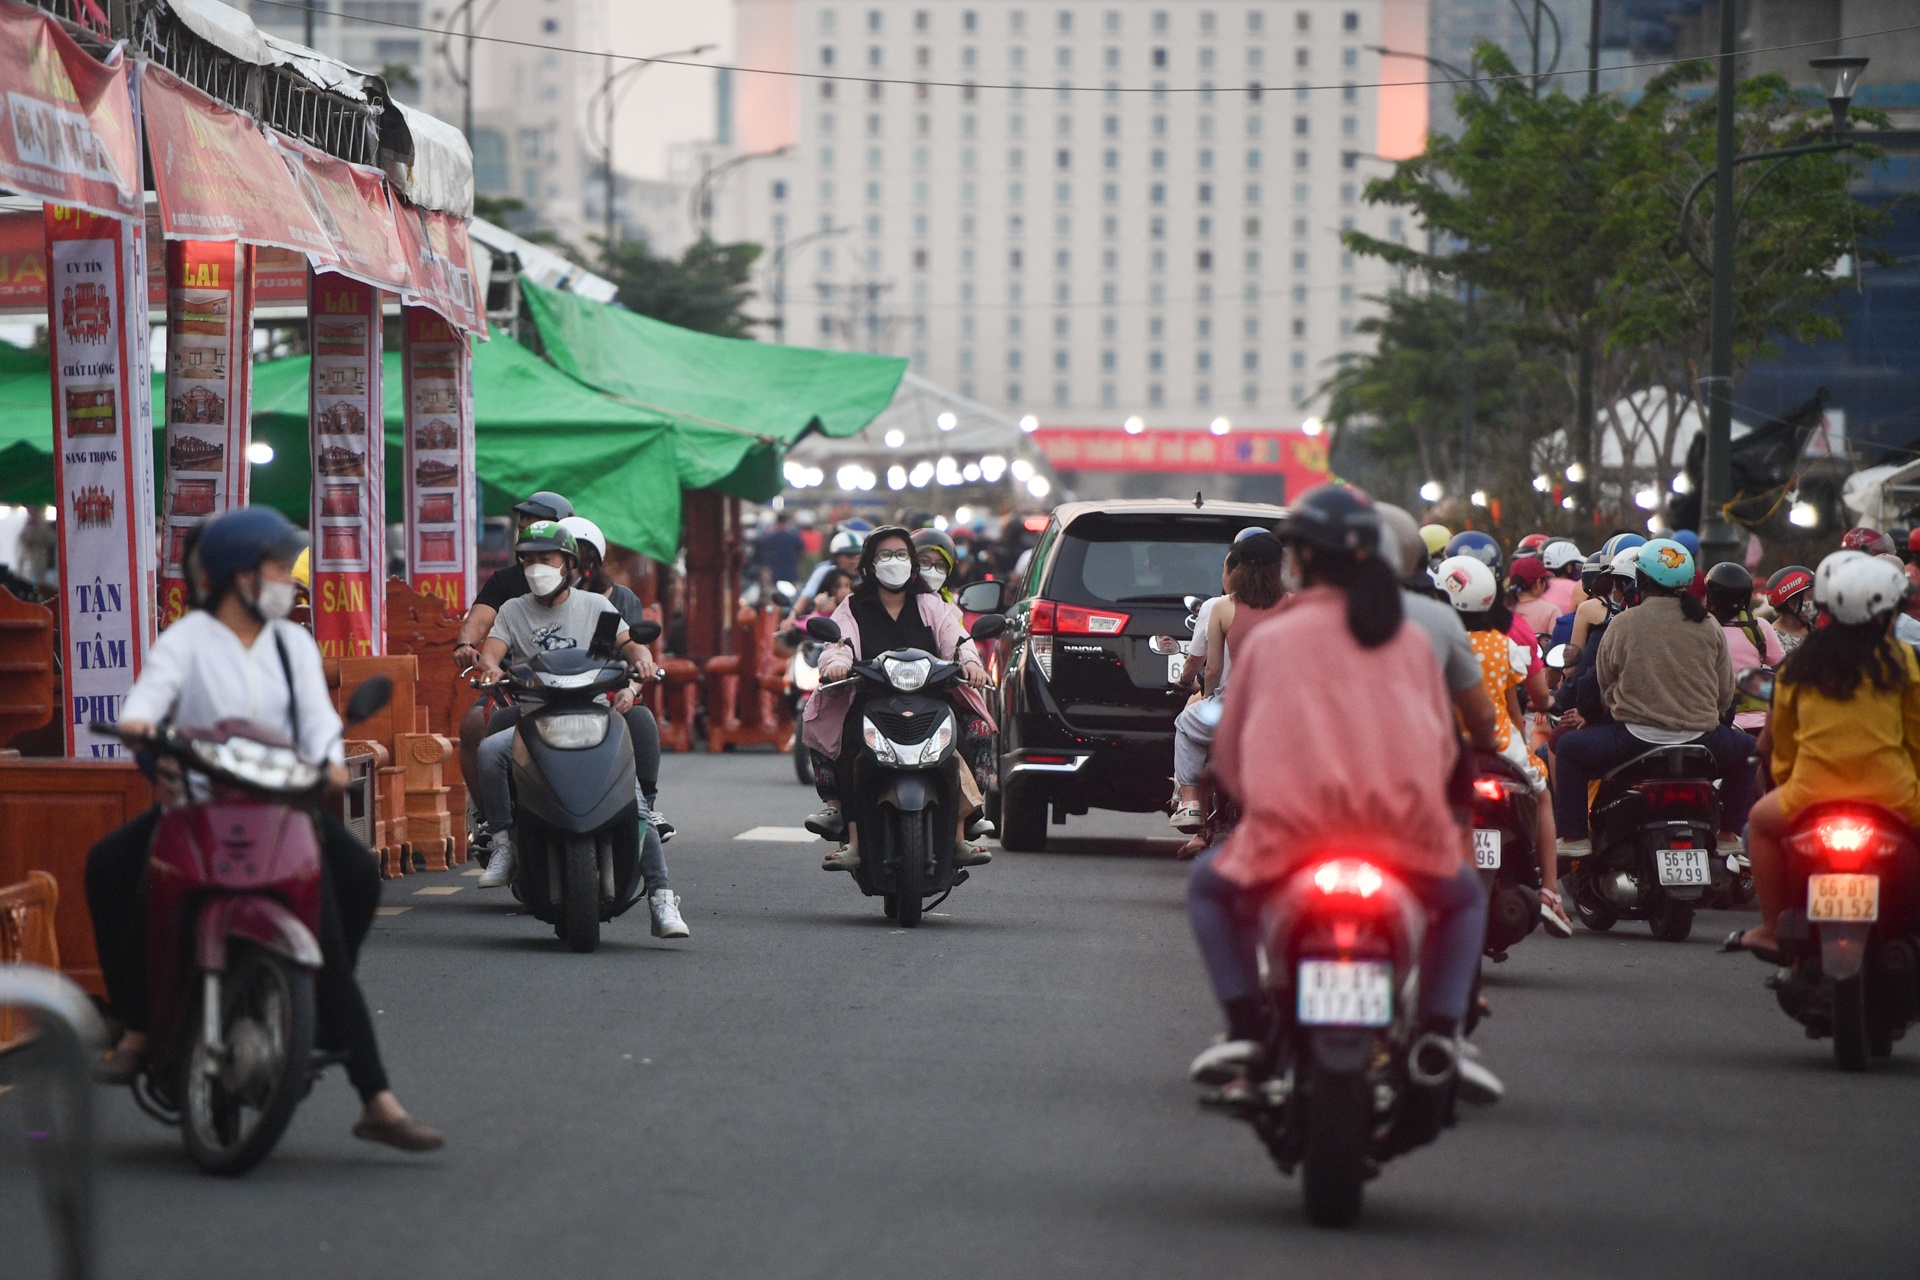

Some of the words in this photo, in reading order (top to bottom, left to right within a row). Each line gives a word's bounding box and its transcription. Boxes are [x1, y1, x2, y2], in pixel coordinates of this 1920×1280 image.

[66, 261, 80, 273] UY
[84, 259, 102, 272] TÍN
[183, 263, 220, 287] LAI
[325, 292, 358, 313] LAI
[63, 360, 86, 377] CHẤT
[87, 361, 115, 378] LƯỢNG
[65, 452, 87, 464] SANG
[89, 451, 117, 465] TRỌNG
[322, 573, 364, 613] SẢN
[1778, 576, 1803, 595] LOSHIP
[76, 576, 122, 621] TẬN
[76, 632, 128, 670] TÂM
[1664, 852, 1699, 866] 56-P1
[1666, 868, 1703, 882] 5299
